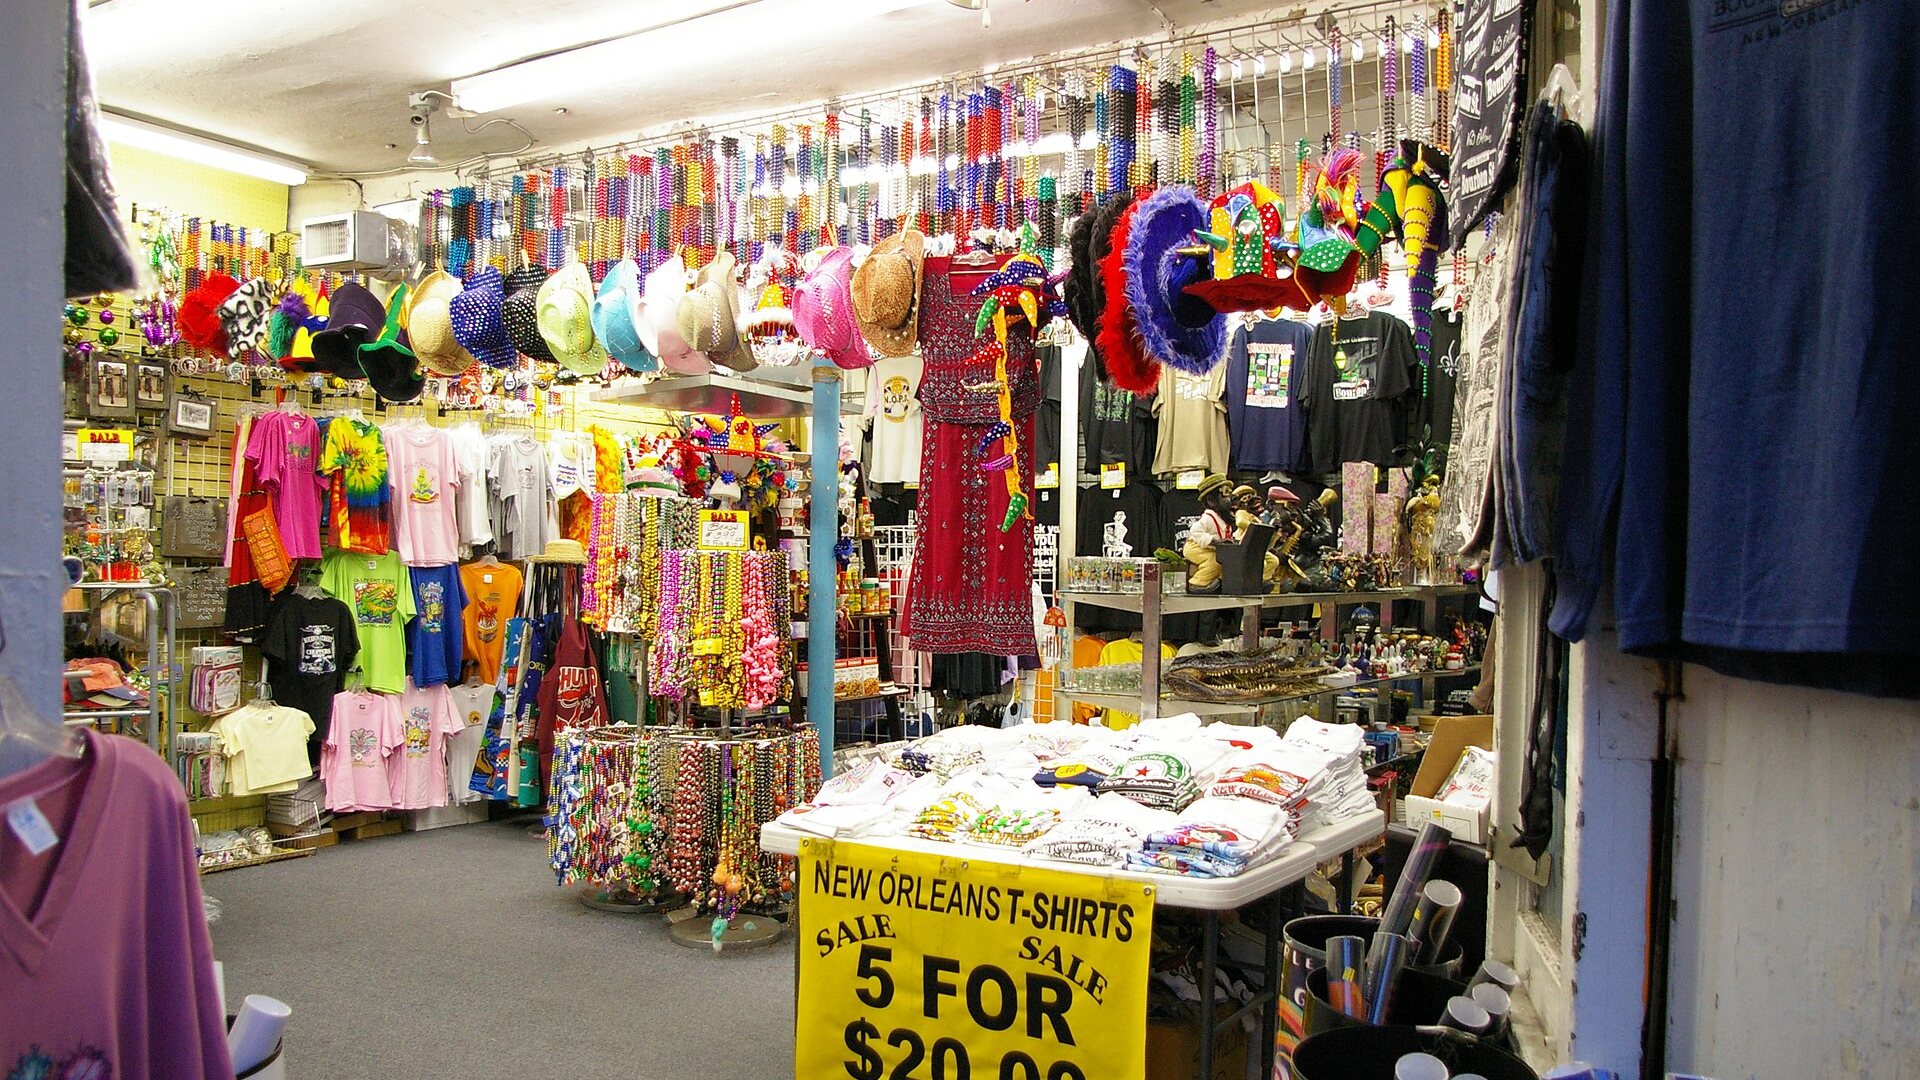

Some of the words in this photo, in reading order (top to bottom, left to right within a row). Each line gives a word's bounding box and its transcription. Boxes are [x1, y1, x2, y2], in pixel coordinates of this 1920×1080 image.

[90, 432, 120, 443] SALE
[711, 512, 737, 522] SALE
[814, 860, 872, 901] NEW
[878, 870, 1001, 921] ORLEANS
[1007, 887, 1135, 943] T-SHIRTS
[816, 913, 897, 958] SALE
[854, 943, 895, 1009] 5
[922, 954, 1077, 1047] FOR
[1018, 935, 1109, 1006] SALE
[843, 1016, 1088, 1080] $20
